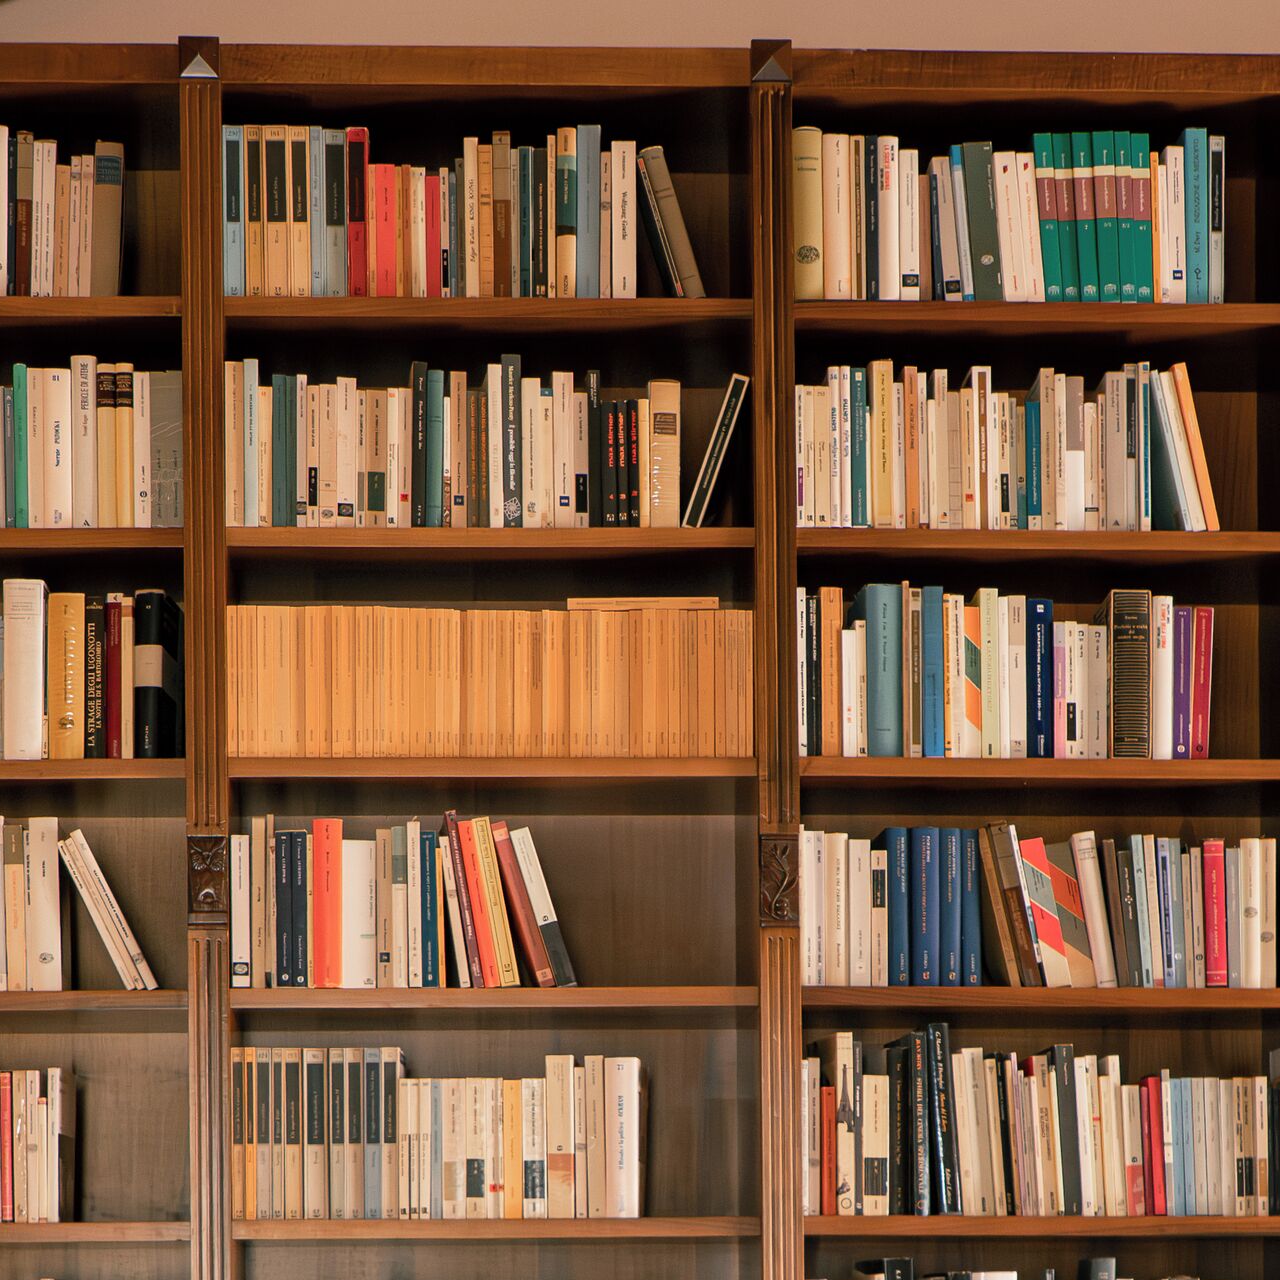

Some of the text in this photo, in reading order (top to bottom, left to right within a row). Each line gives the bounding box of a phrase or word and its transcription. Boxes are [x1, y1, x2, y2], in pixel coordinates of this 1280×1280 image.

[79, 362, 89, 381] ATENE
[79, 388, 89, 411] PERICLE
[607, 412, 615, 468] max stirner
[617, 412, 626, 467] max stirner
[87, 622, 96, 747] LA STRAGE DEGLI UGONOTTI
[95, 690, 102, 698] DI
[95, 721, 102, 729] LA
[916, 1077, 924, 1102] STORIA
[916, 1103, 924, 1116] DEL
